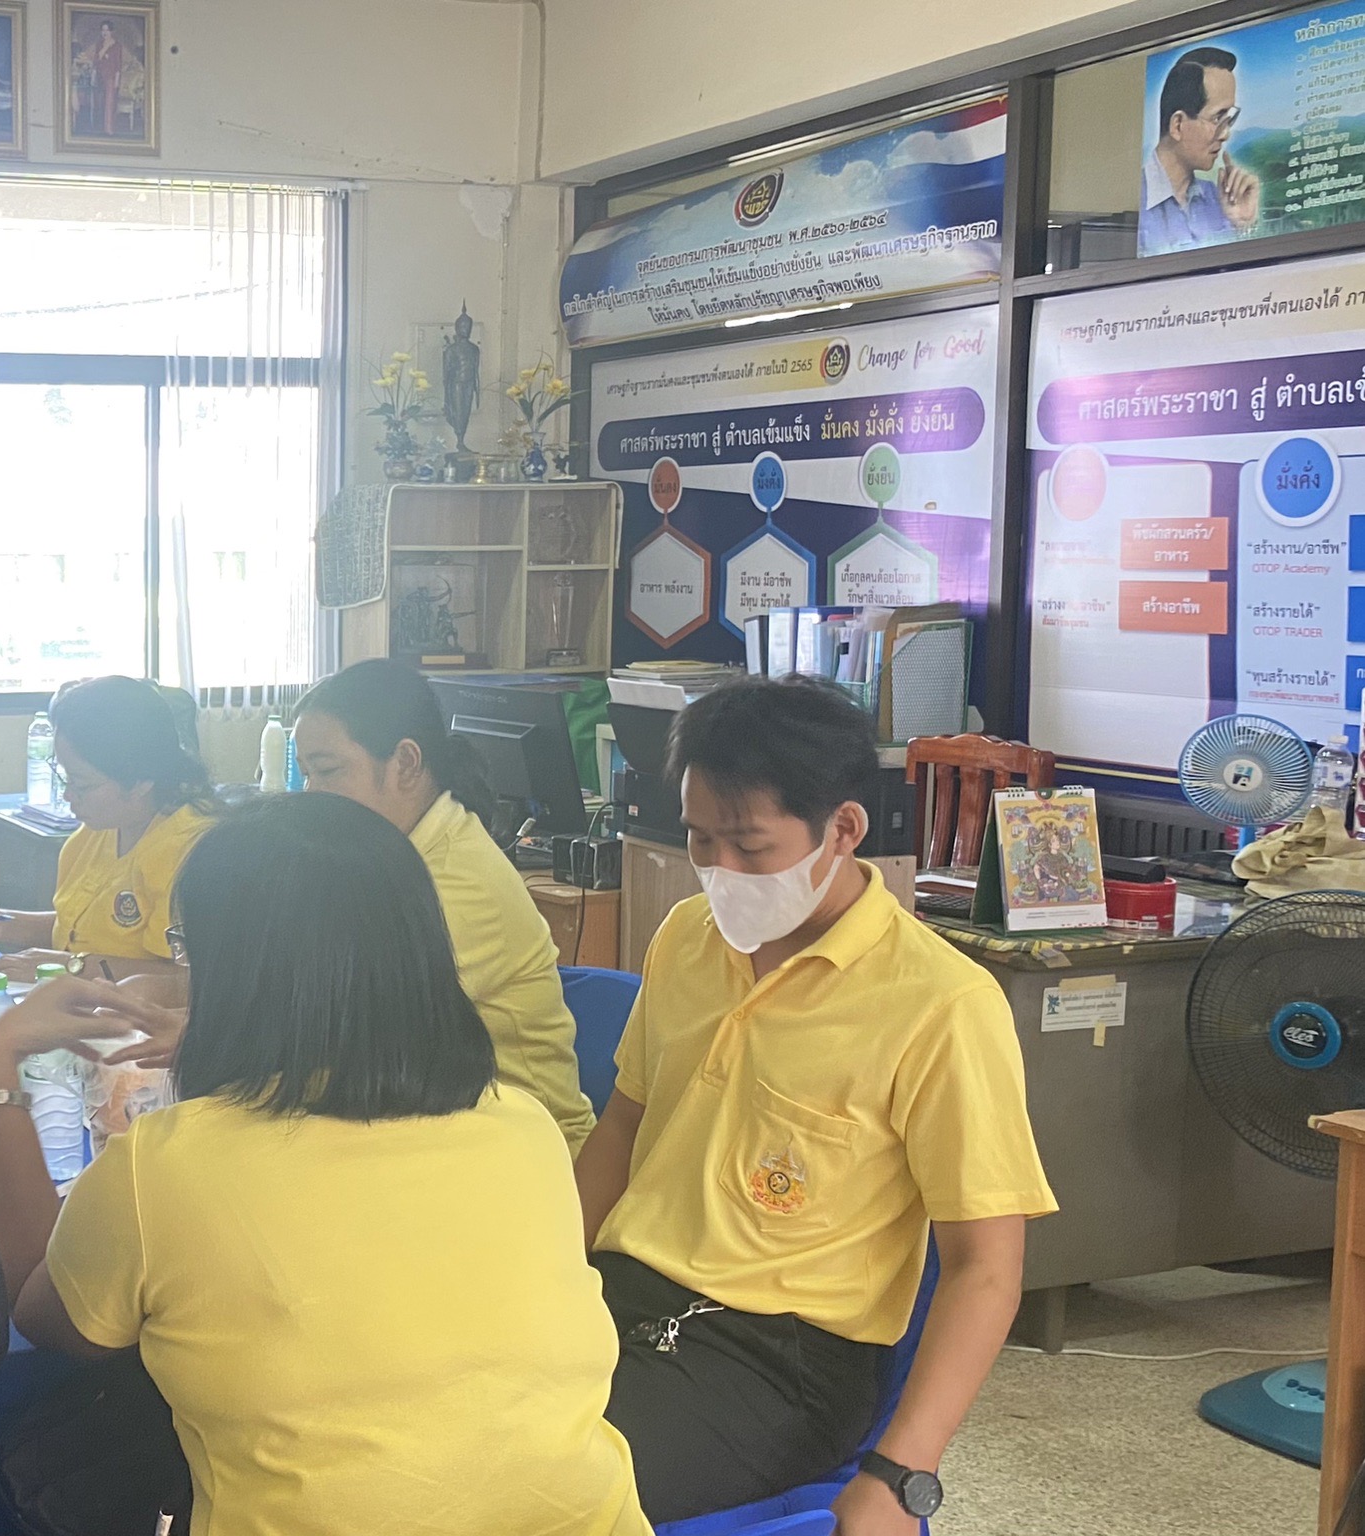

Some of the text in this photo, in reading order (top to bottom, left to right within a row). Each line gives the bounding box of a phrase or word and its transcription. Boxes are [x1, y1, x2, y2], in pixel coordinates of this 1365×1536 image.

[1060, 286, 1343, 342] เศรษฐกิจฐานรากมั่นคงและชุมชนพึ่งตนเองได้
[790, 358, 813, 373] 2565
[858, 329, 985, 371] Change for Good
[1078, 386, 1238, 421] ศาสตร์พระราชา
[1250, 376, 1268, 421] สู่
[620, 400, 955, 455] ศาสตร์พระราชา สู่ ตำบลเข้มแข็ง มั่นคง มั่งคั่ง ยั่งยืน
[1276, 460, 1321, 491] มั่งคั่ง
[1252, 563, 1330, 576] OTOP Academy
[1253, 626, 1323, 638] OTOP TRADER
